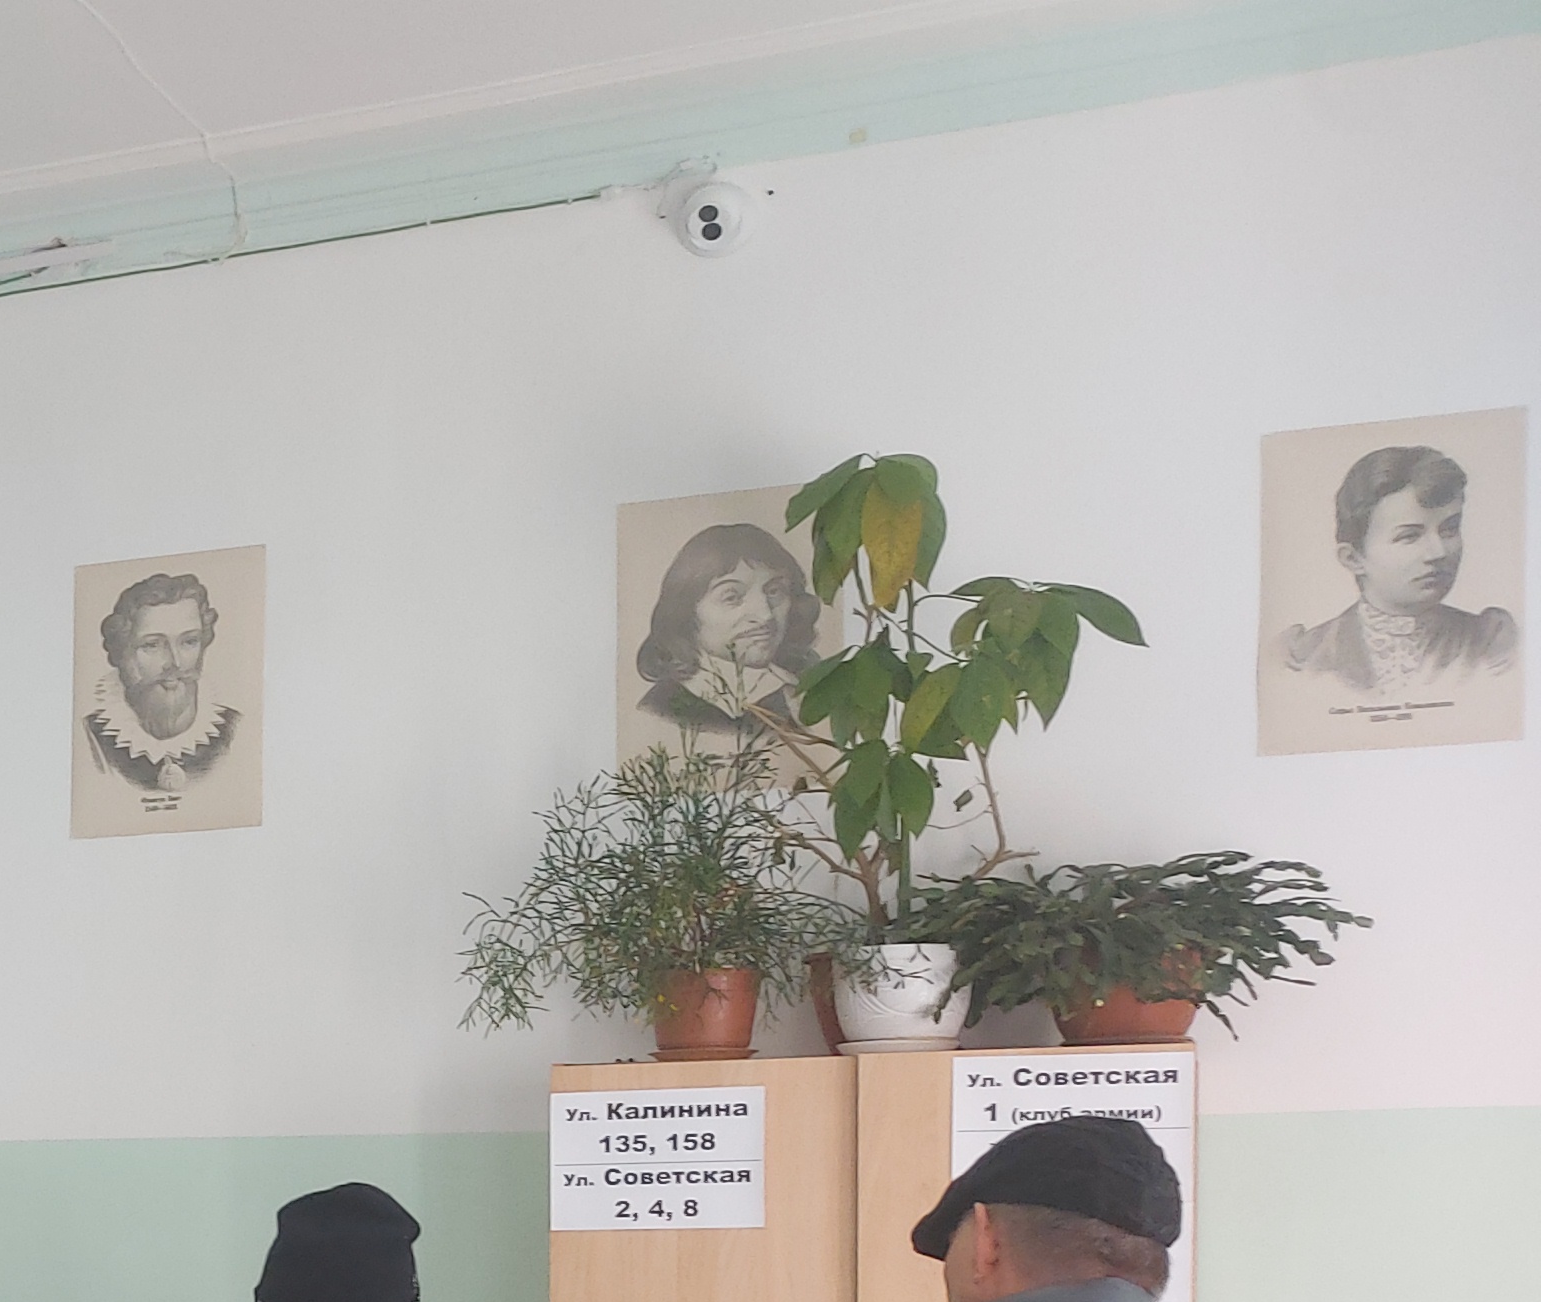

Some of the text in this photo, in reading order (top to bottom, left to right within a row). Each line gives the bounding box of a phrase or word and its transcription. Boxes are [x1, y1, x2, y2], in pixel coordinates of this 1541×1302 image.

[1013, 1068, 1180, 1087] Советская
[606, 1102, 749, 1121] Калинина
[983, 1102, 997, 1122] 1
[1011, 1105, 1072, 1125] (клуб
[598, 1132, 716, 1156] 135, 158
[604, 1167, 753, 1186] Советская
[614, 1199, 699, 1222] 2, 4, 8
